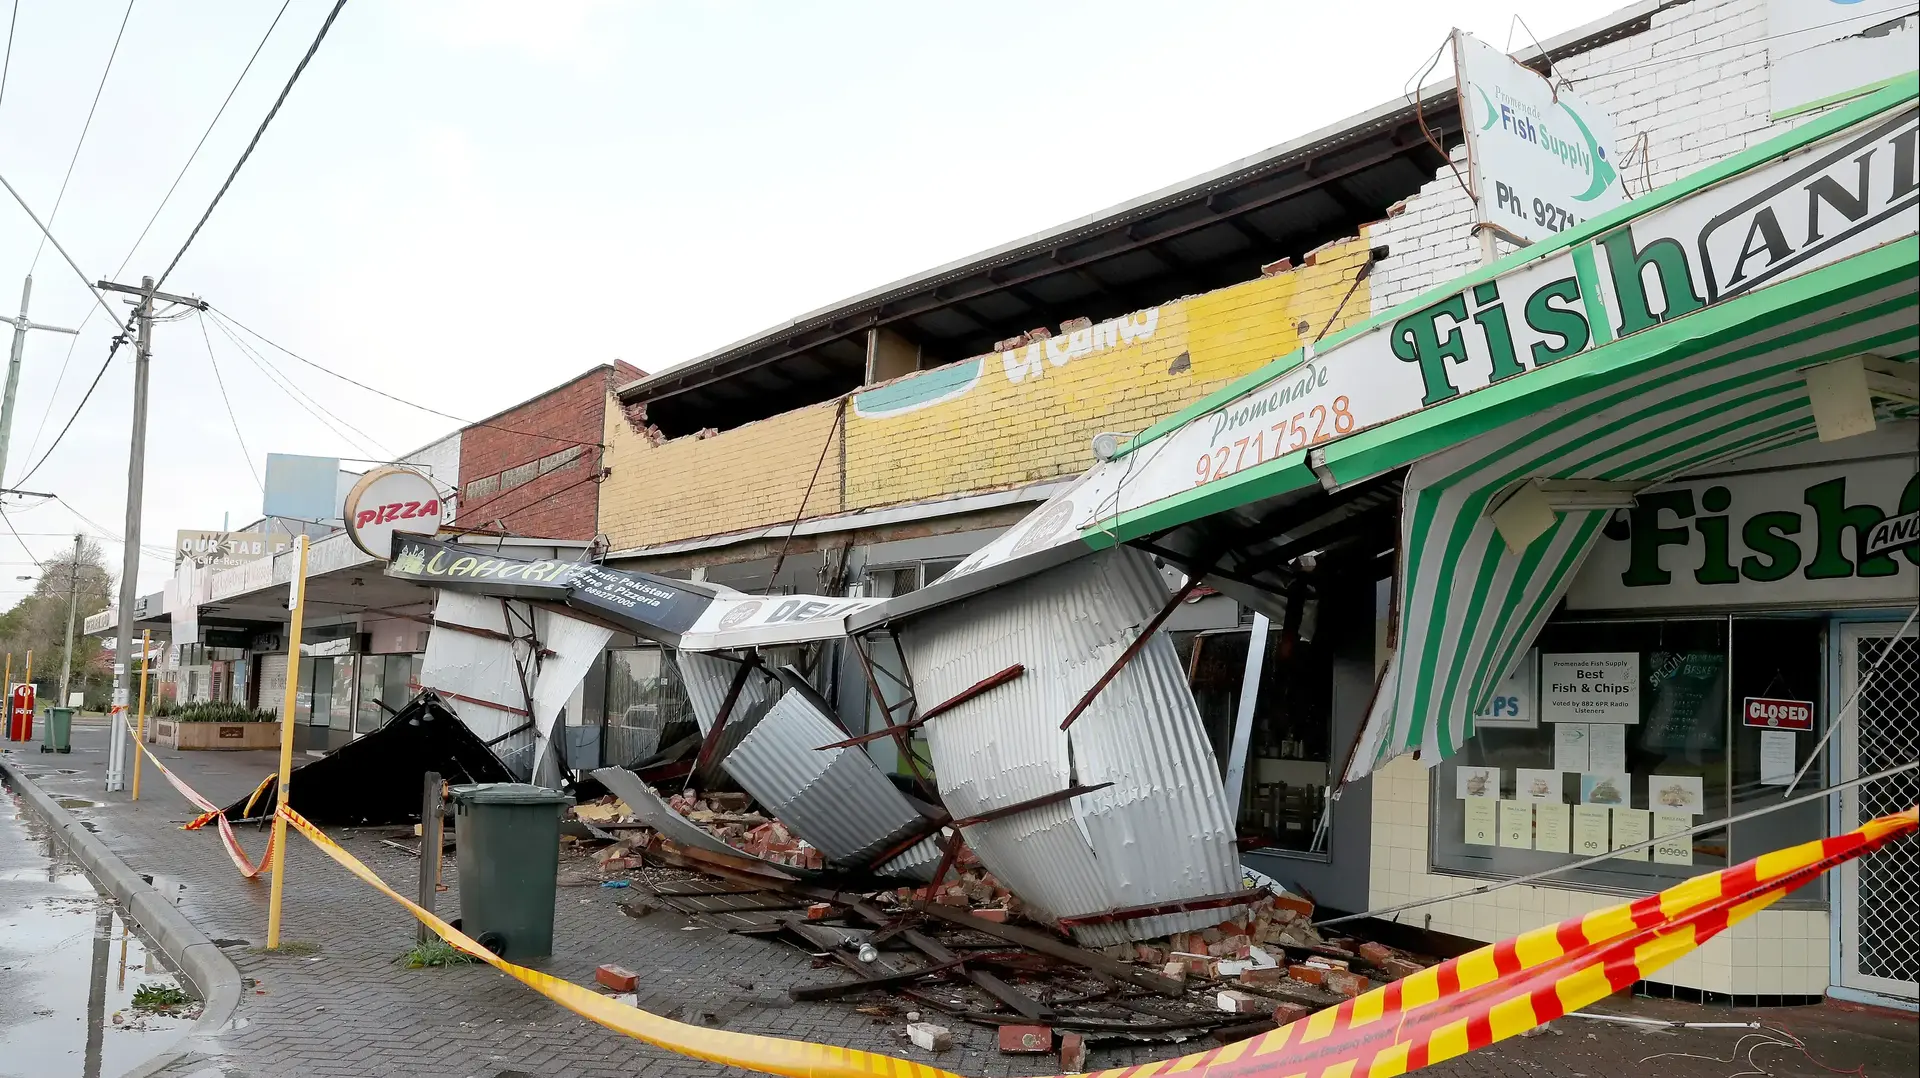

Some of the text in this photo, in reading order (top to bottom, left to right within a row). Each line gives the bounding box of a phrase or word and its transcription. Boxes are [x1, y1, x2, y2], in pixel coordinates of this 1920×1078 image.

[1494, 85, 1541, 120] Promenade
[1500, 104, 1590, 176] Fish Supply
[1496, 180, 1527, 219] Ph.
[1390, 225, 1709, 407] Fish
[1208, 363, 1328, 448] Promenade
[1195, 395, 1354, 487] 92717528
[357, 499, 438, 529] PIZZA
[182, 538, 218, 553] OUR
[1601, 476, 1899, 588] Fish
[426, 551, 570, 582] LAHORI
[569, 577, 636, 608] Ph: 0892727005
[604, 583, 614, 591] &
[614, 586, 661, 607] Pizzeria
[619, 577, 675, 600] Pakistani
[1577, 669, 1604, 679] Best
[1649, 653, 1686, 687] SPECIAL
[1552, 683, 1630, 695] Fish & Chips
[1750, 702, 1809, 721] CLOSED
